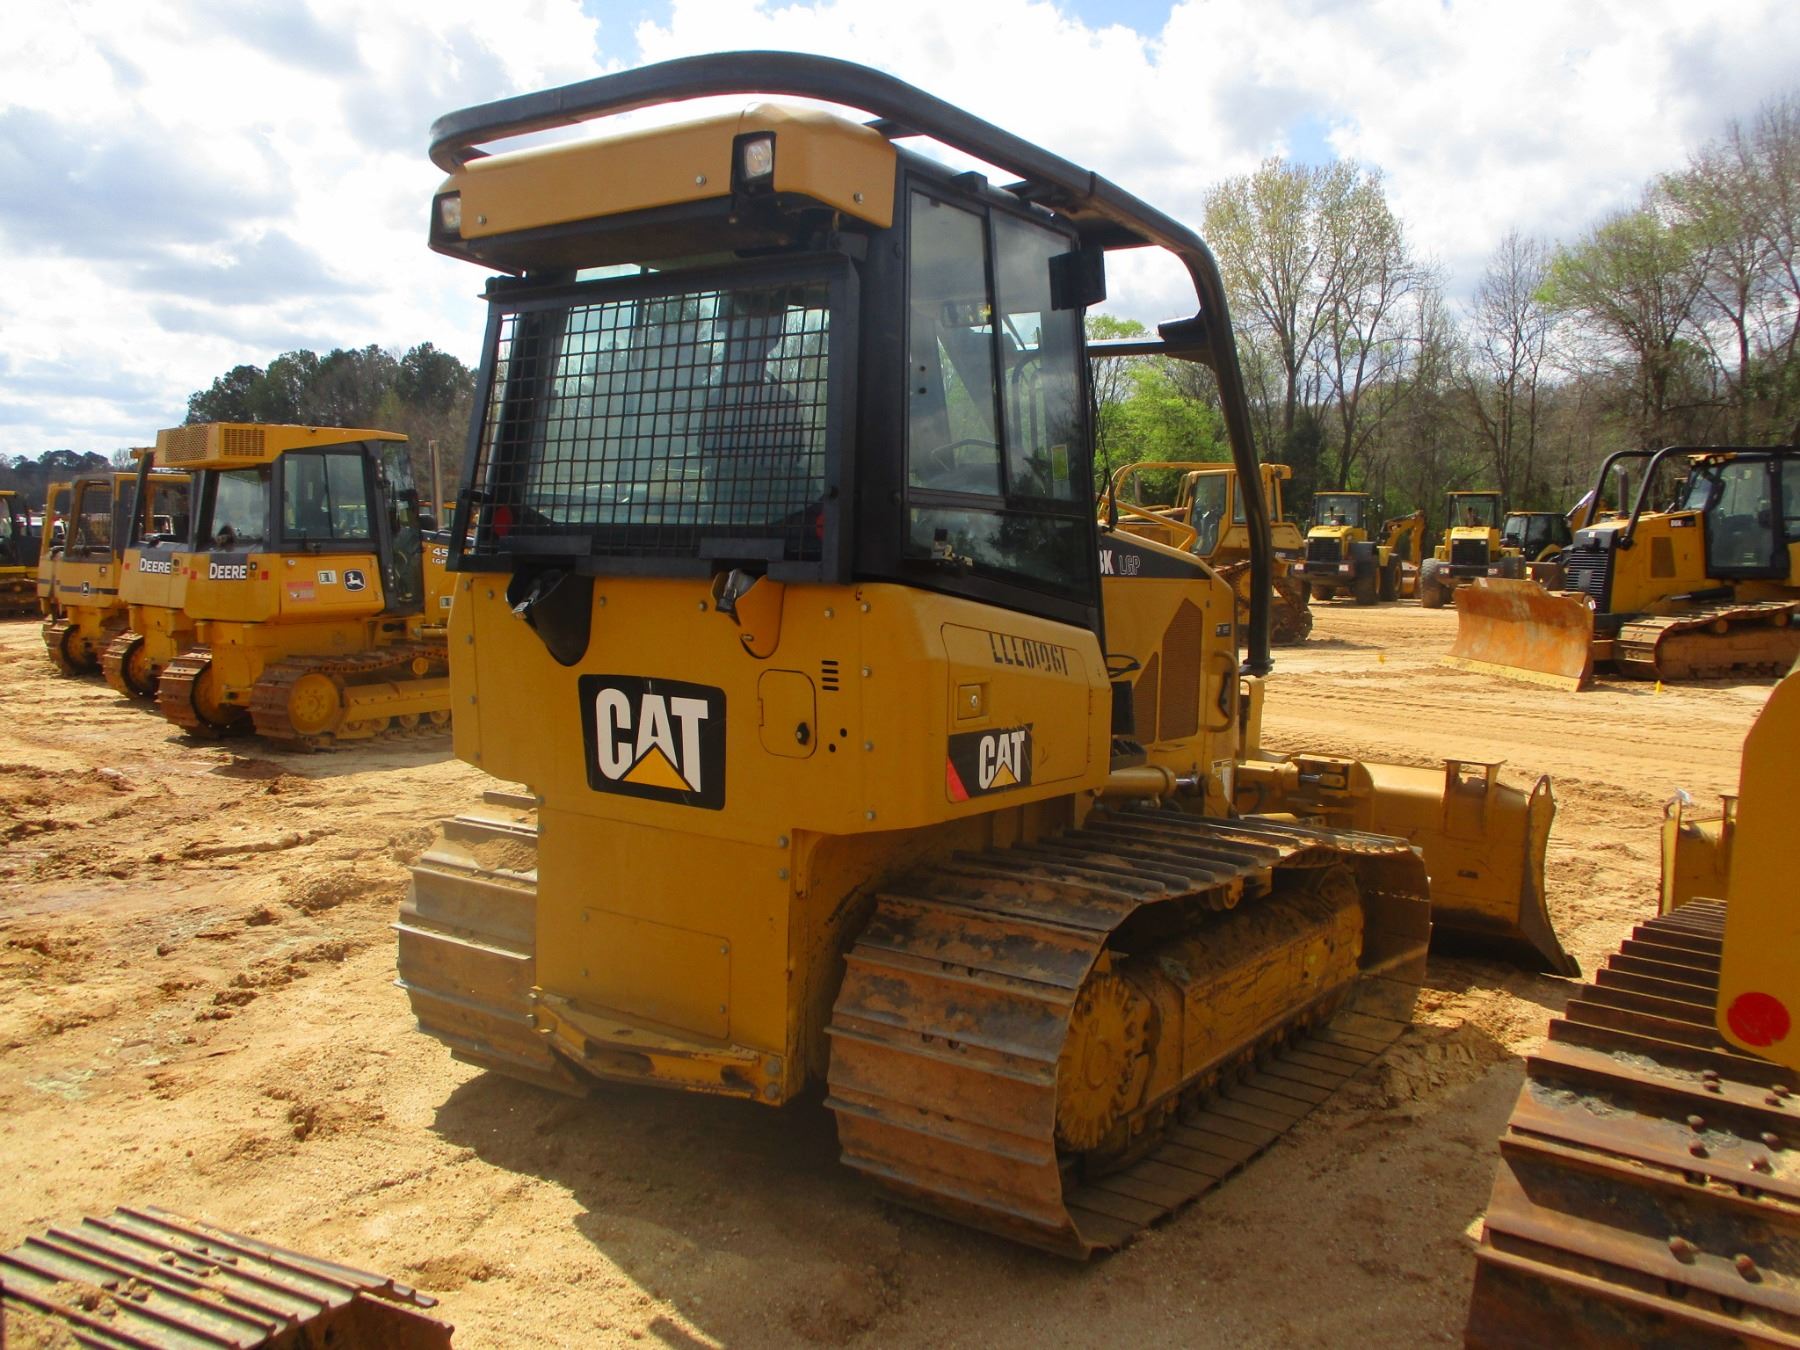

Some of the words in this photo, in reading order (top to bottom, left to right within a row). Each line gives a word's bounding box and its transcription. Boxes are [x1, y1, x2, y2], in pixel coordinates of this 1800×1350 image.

[140, 557, 172, 574] DEERE
[208, 562, 248, 580] DEERE
[1118, 554, 1141, 576] LGP
[595, 687, 709, 793] CAT
[978, 730, 1026, 790] CAT
